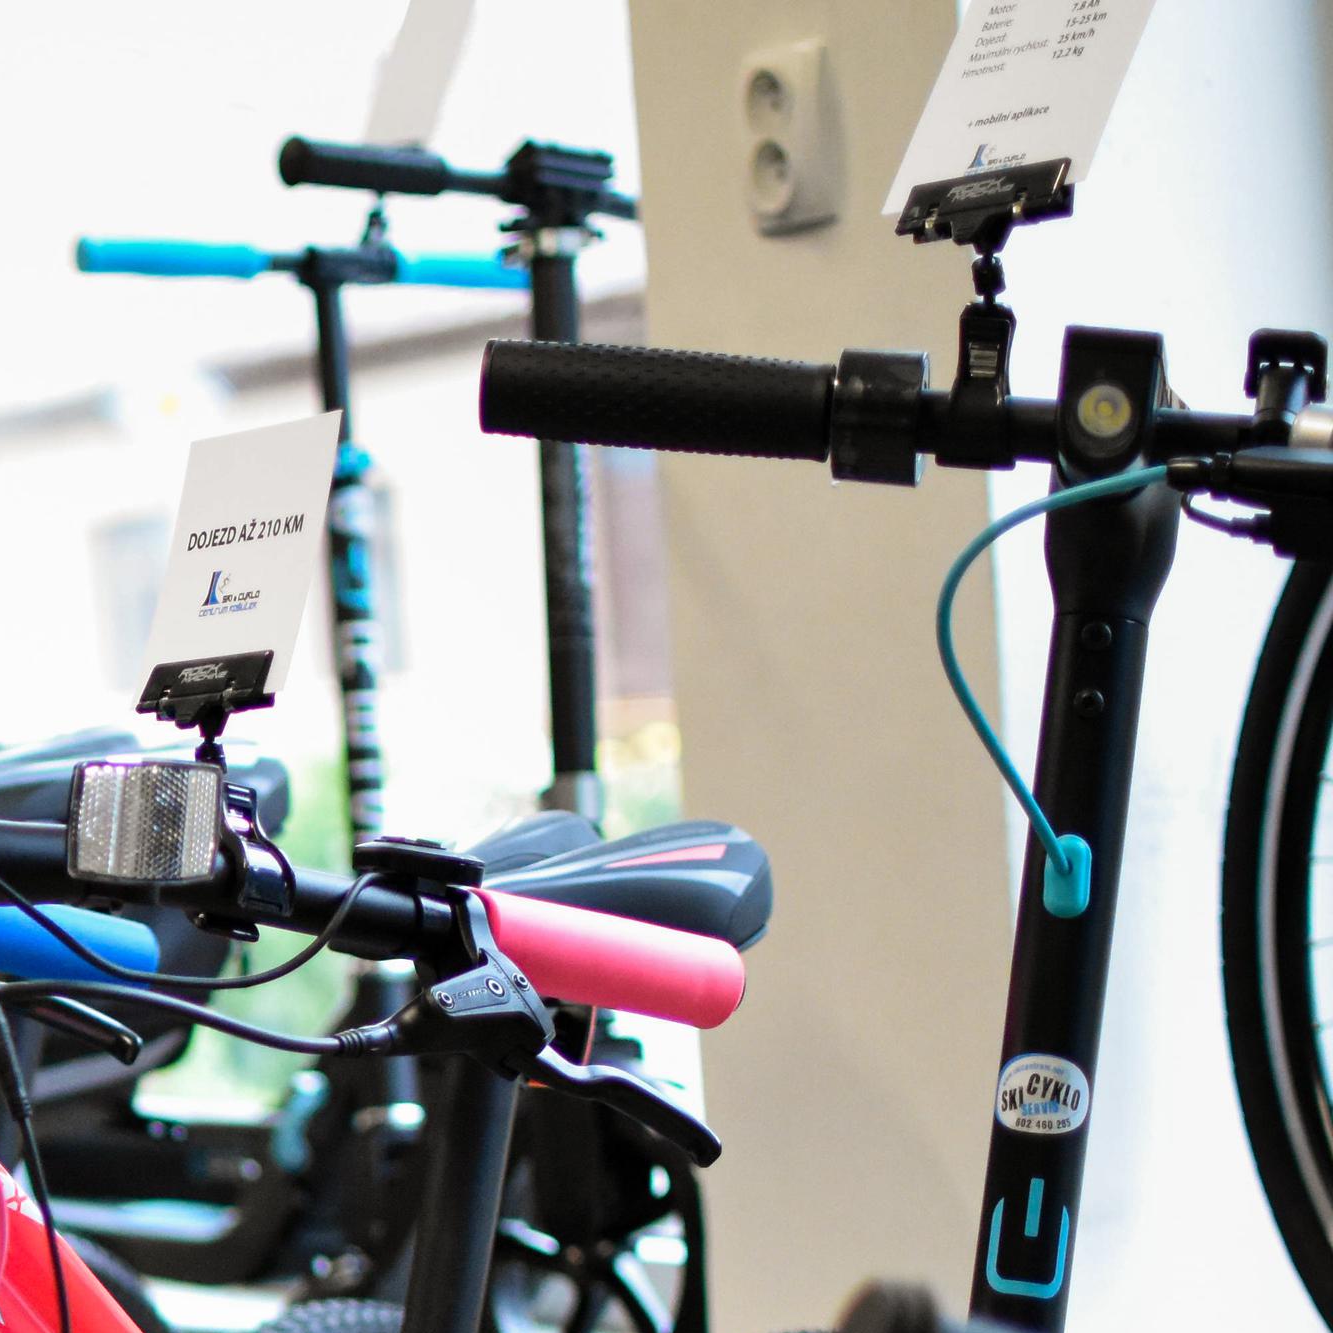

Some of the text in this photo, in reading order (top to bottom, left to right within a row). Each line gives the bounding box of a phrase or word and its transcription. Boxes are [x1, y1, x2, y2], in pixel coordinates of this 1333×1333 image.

[1091, 12, 1108, 22] km
[1057, 34, 1070, 45] 25
[1072, 46, 1085, 57] kg
[974, 111, 1011, 128] mobilní
[1011, 105, 1050, 121] aplikace
[187, 513, 304, 551] DOJEZD AŽ 210 KM
[1001, 1085, 1024, 1112] SKI
[1026, 1073, 1081, 1112] CYKLO
